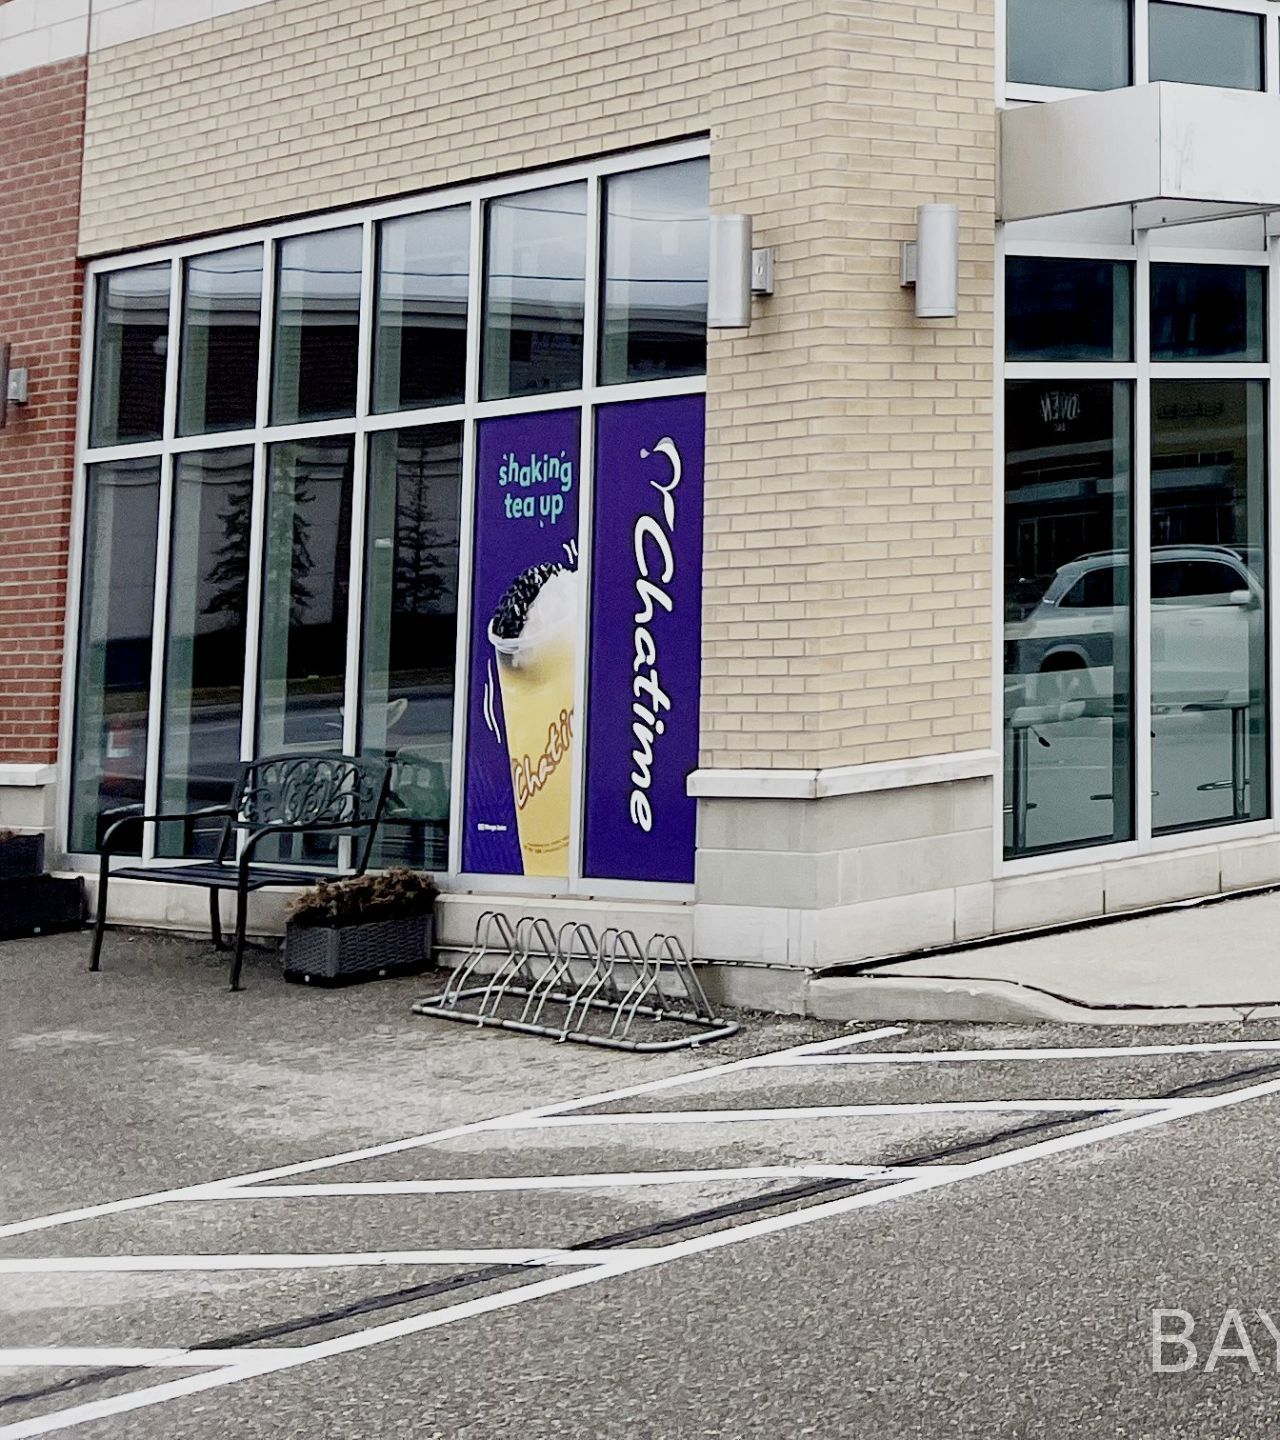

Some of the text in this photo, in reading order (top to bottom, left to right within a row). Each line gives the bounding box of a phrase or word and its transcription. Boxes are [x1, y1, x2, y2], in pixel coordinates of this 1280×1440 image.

[498, 452, 573, 493] shaking
[504, 493, 564, 524] tea up
[630, 515, 675, 832] Chatime
